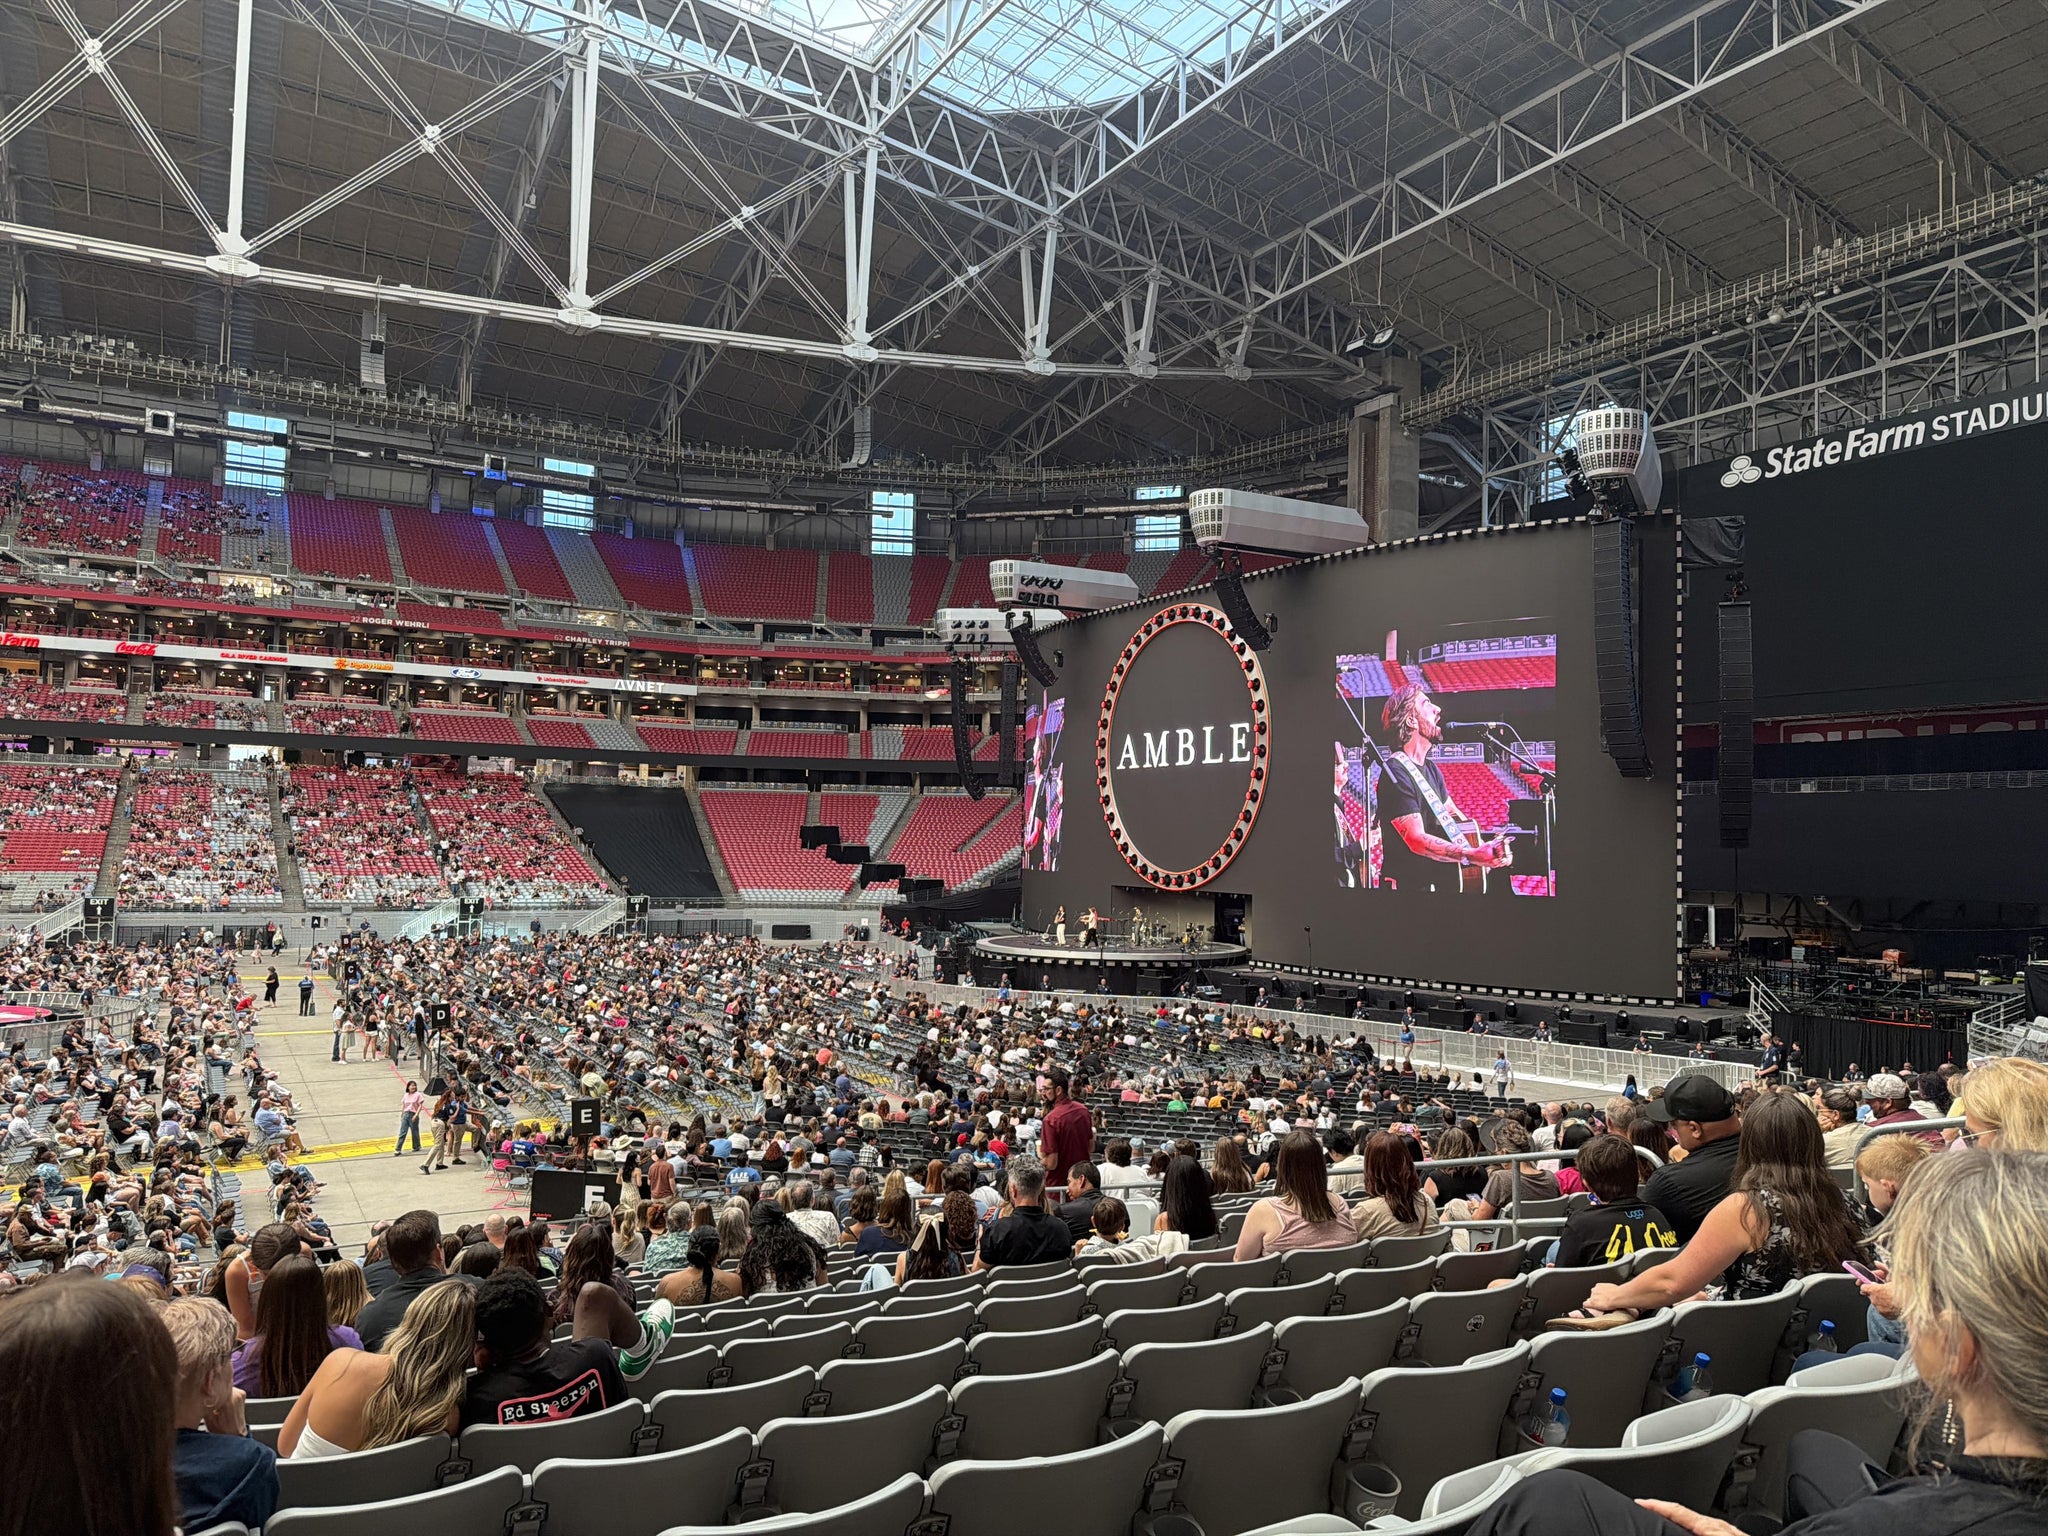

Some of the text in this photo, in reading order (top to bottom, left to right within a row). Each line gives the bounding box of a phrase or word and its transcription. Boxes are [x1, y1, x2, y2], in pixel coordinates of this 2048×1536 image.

[1930, 392, 2048, 442] STADIU
[362, 617, 393, 625] ROGER
[395, 619, 430, 629] WEHRLI
[565, 635, 604, 645] CHARLEY
[605, 639, 630, 648] TRIPPI
[614, 679, 665, 693] AVNET
[1116, 722, 1251, 770] AMBLE
[90, 898, 109, 906] EXIT
[347, 965, 355, 974] C
[437, 1010, 446, 1020] D
[581, 1108, 593, 1123] E
[503, 1379, 599, 1421] Ed Sheeran
